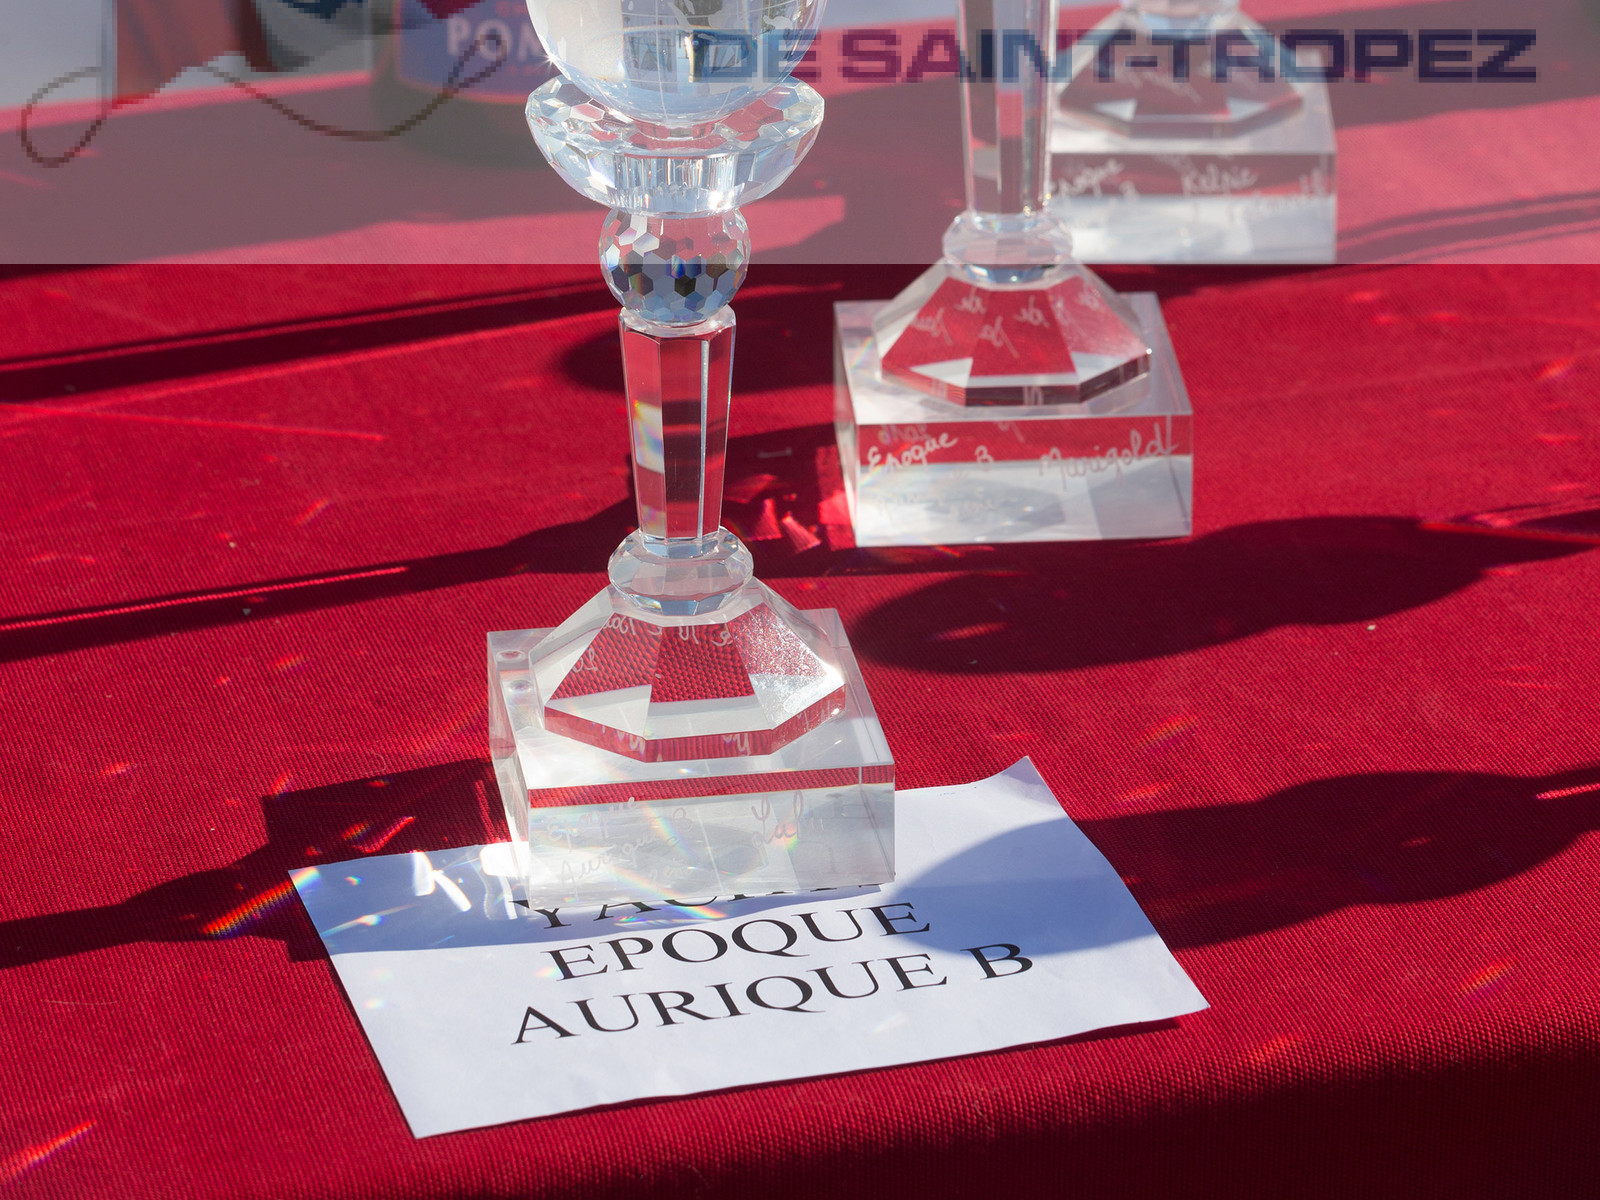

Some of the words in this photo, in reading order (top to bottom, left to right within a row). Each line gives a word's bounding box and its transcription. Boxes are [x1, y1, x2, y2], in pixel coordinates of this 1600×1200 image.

[541, 901, 931, 981] EPOQUE
[511, 952, 949, 1046] AURIQUE
[960, 942, 1034, 981] B
